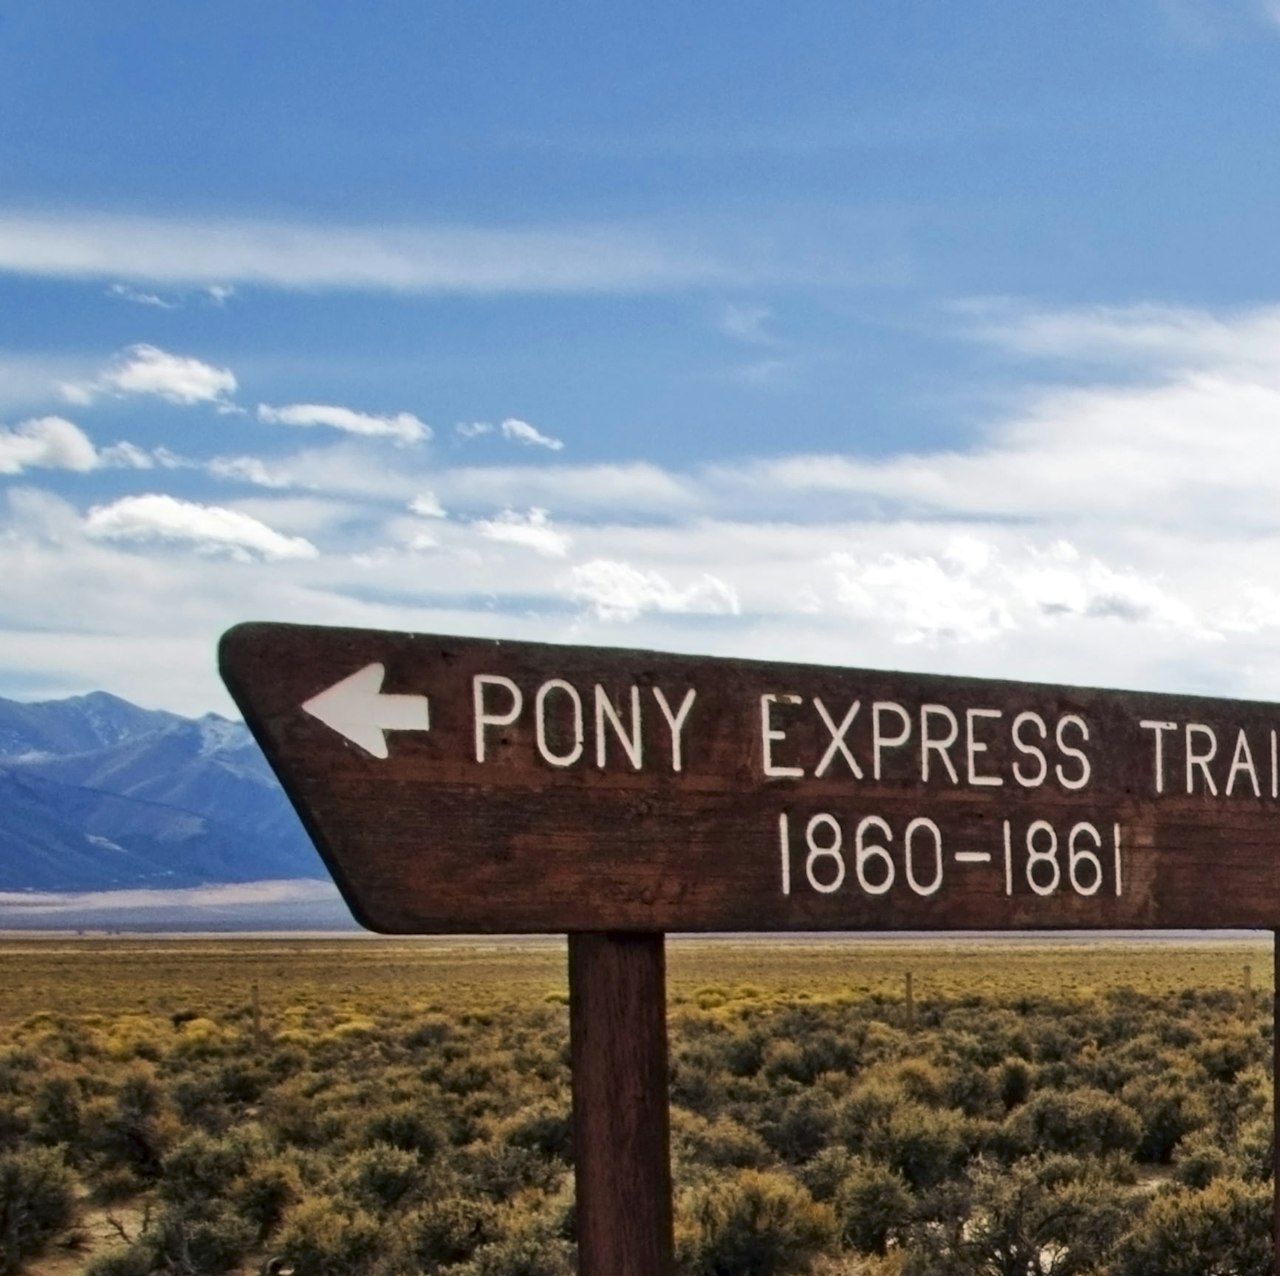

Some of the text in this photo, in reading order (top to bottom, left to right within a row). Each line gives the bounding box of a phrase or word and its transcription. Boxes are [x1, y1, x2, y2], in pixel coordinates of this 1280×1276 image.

[473, 674, 697, 772] PONY
[760, 693, 1091, 790] EXPRESS
[779, 812, 1123, 897] 1860-1861
